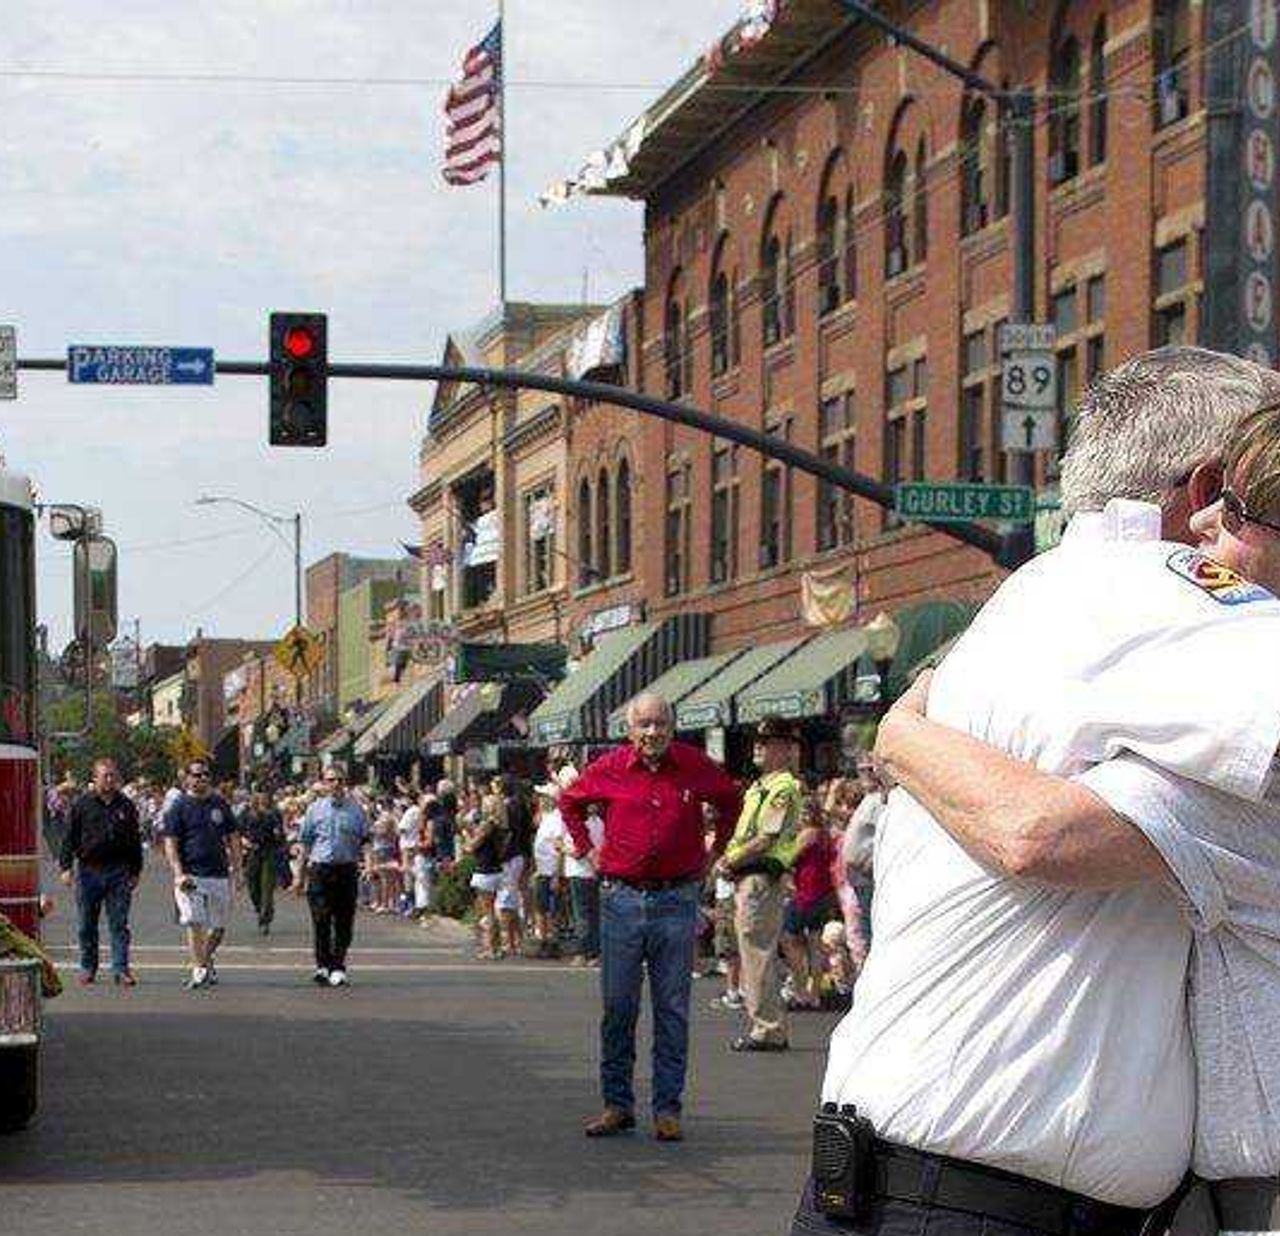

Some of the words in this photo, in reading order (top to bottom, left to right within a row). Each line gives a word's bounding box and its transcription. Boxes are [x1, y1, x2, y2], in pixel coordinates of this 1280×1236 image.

[98, 365, 169, 382] GARAGE
[1007, 365, 1051, 395] 89
[907, 488, 990, 515] GURLEY
